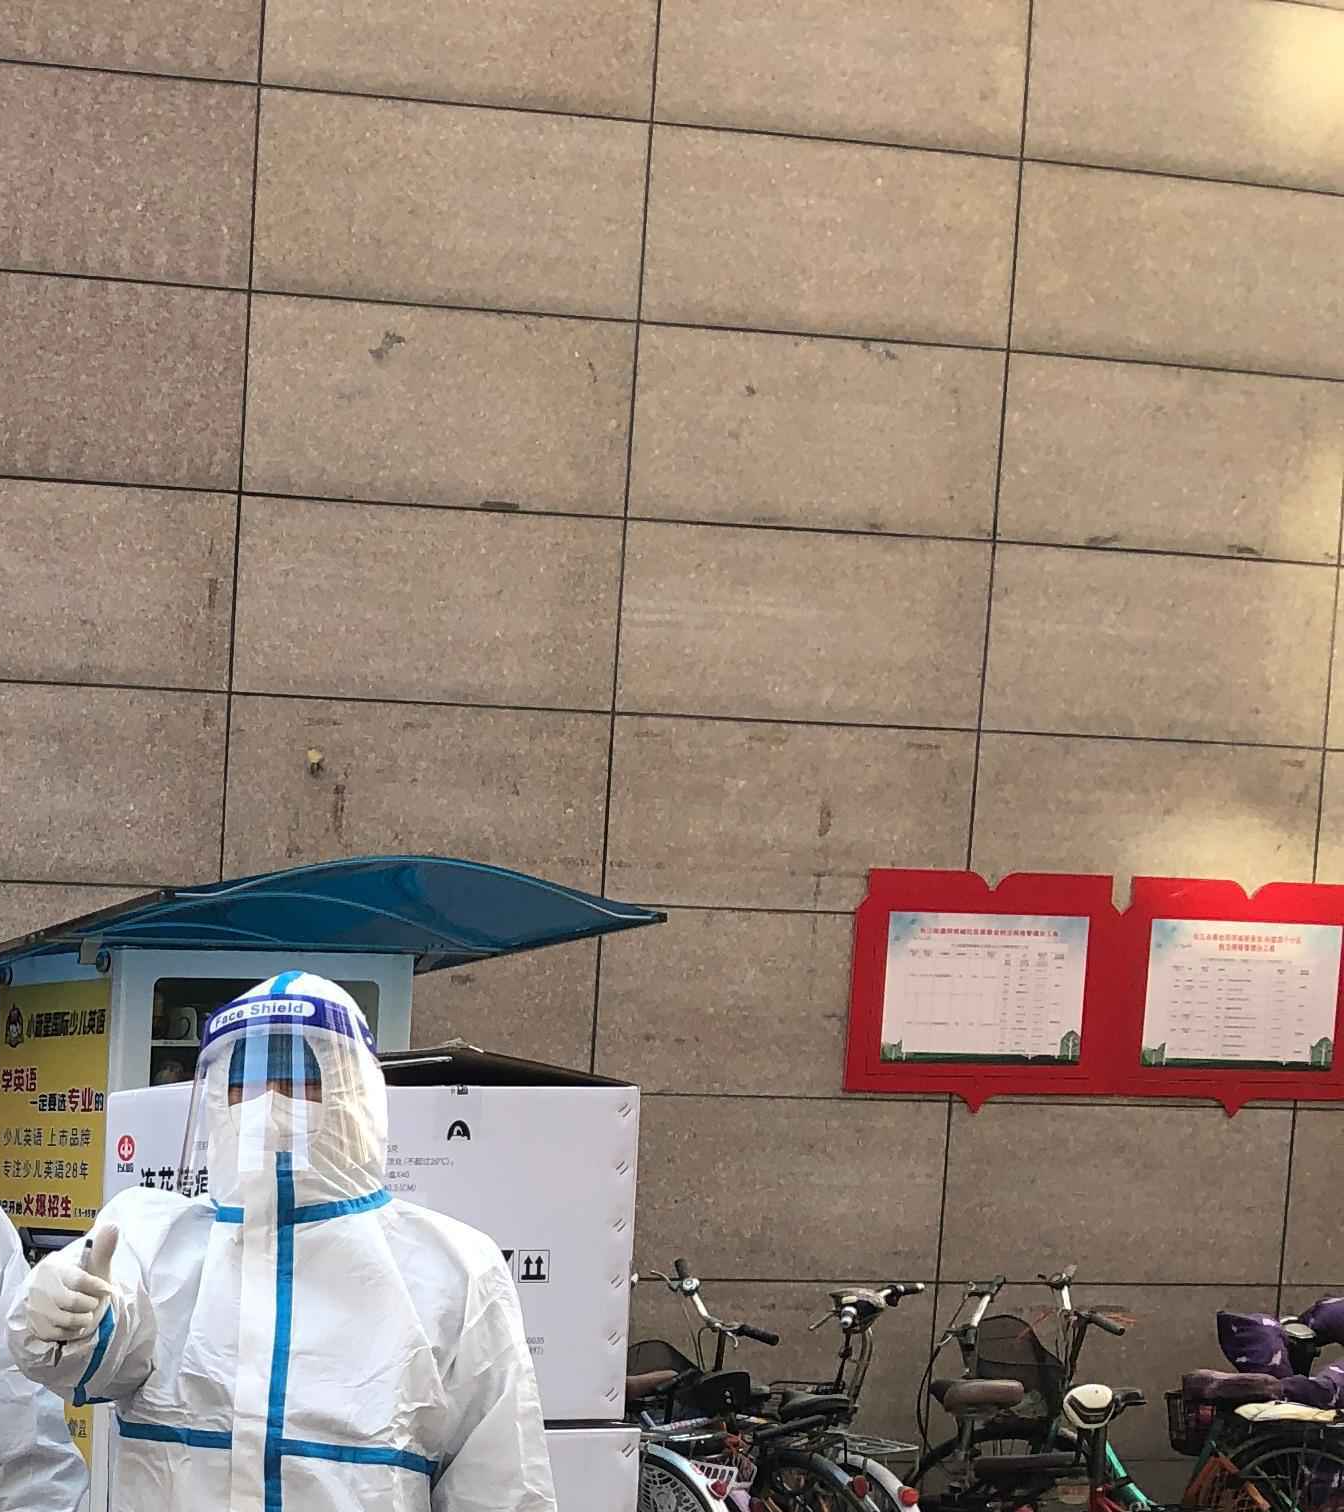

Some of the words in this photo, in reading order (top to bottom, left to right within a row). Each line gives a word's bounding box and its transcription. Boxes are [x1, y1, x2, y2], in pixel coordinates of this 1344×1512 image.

[214, 1009, 244, 1028] Face
[250, 1002, 303, 1016] Shield
[1, 1067, 38, 1093] 学英语
[29, 1088, 105, 1113] 一定要选专业的
[3, 1128, 43, 1147] 少儿英语
[47, 1127, 92, 1147] 上市品牌
[2, 1160, 89, 1181] 专注少儿英语28年
[0, 1193, 72, 1218] 已开始火爆招生
